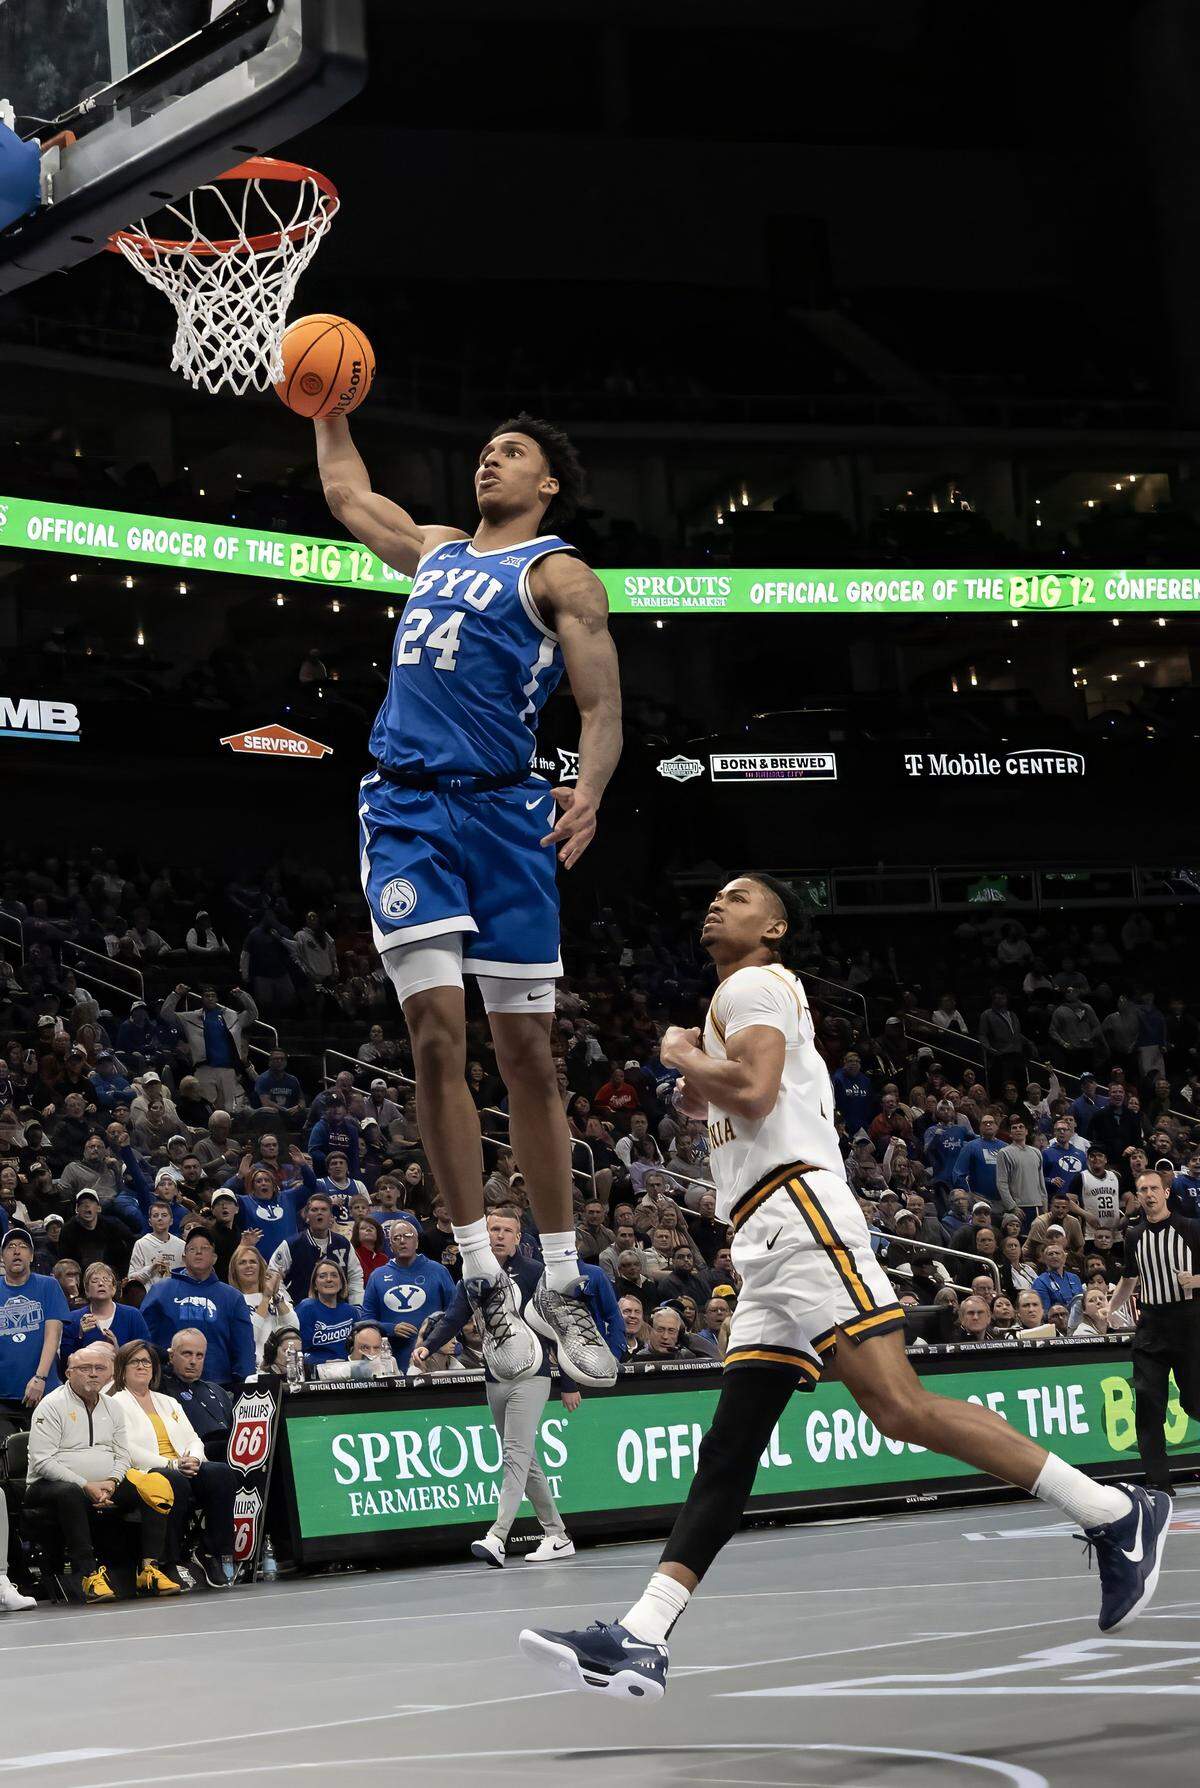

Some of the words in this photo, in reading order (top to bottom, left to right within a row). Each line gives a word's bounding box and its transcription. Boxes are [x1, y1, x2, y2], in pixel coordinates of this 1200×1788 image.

[27, 516, 119, 548] OFFICIAL
[126, 526, 207, 559] GROCER
[213, 536, 239, 561] OF
[245, 539, 285, 567] THE
[290, 542, 341, 580] BIG
[349, 550, 374, 582] 12
[408, 567, 503, 612] BYU
[624, 575, 733, 596] SPROUTS
[750, 581, 839, 604] OFFICIAL
[845, 579, 925, 602] GROCER
[932, 579, 958, 601] OF
[963, 578, 1005, 601] THE
[1009, 575, 1062, 608] BIG
[1069, 576, 1096, 607] 12
[631, 597, 680, 607] FARMERS
[682, 597, 728, 607] MARKET
[397, 608, 466, 672] 24
[0, 697, 80, 732] MB
[243, 736, 309, 754] SERVPRO
[540, 757, 556, 770] the
[720, 758, 758, 770] BORN
[759, 758, 769, 769] &
[771, 757, 827, 769] BREWED
[927, 753, 1001, 776] Mobile
[1005, 757, 1080, 775] CENTER
[1097, 1196, 1114, 1209] 32
[389, 1287, 420, 1310] Y
[238, 1404, 270, 1420] PHILLIPS
[235, 1425, 264, 1457] 66
[617, 1414, 793, 1484] OFFIL
[1017, 1383, 1090, 1438] THE
[331, 1419, 568, 1485] SPROUS
[234, 1500, 256, 1515] ILLIPS
[348, 1484, 461, 1517] FARMERS
[464, 1475, 563, 1507] MAT
[234, 1522, 250, 1553] 6
